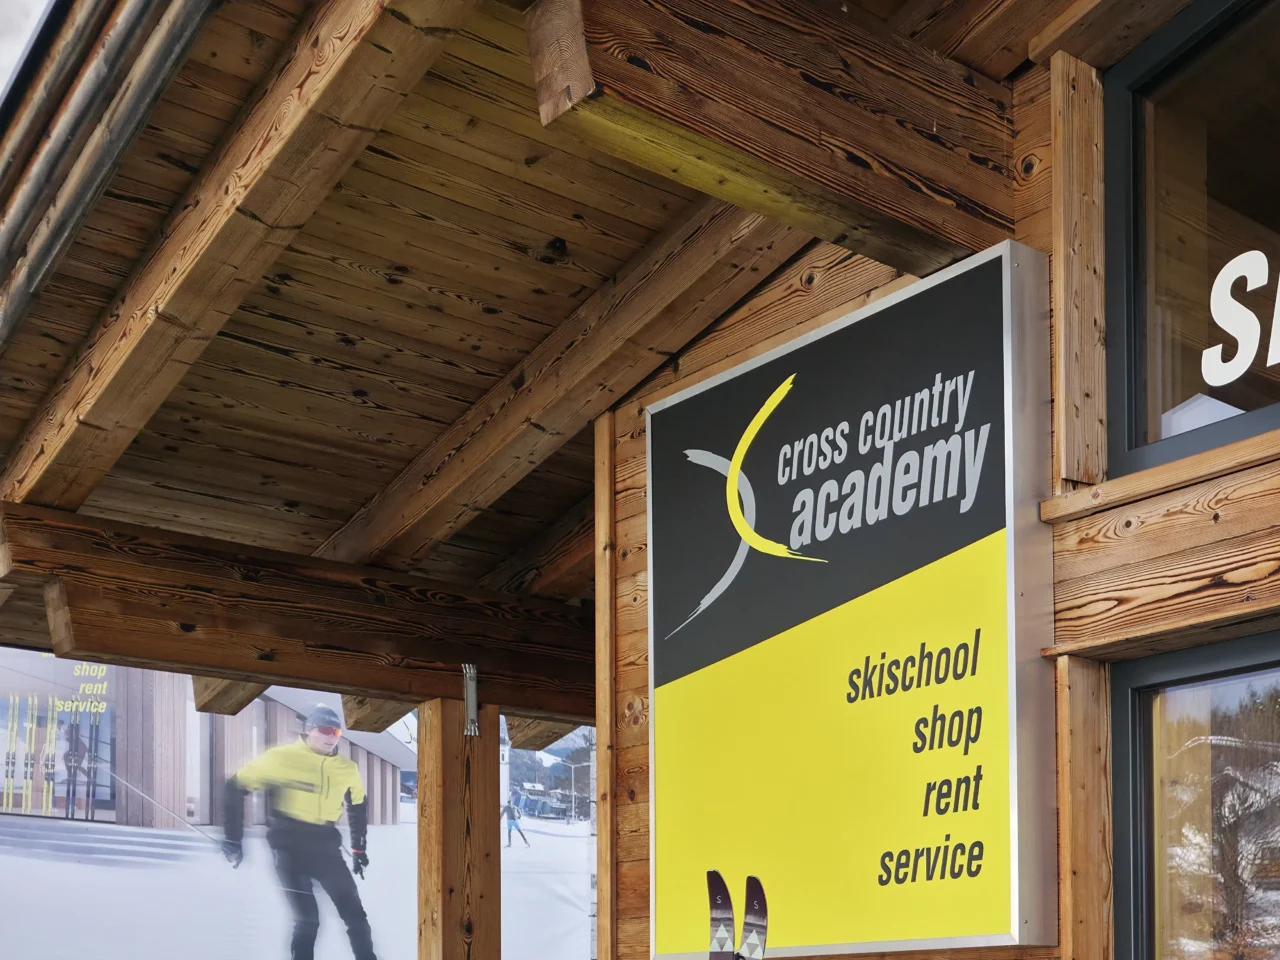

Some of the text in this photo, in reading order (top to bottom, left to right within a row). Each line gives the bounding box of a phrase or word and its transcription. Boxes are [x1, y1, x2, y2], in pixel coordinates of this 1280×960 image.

[777, 370, 975, 486] cross country
[789, 423, 991, 551] academy
[73, 661, 107, 679] shop
[79, 681, 107, 695] rent
[846, 629, 982, 703] skischool
[56, 697, 107, 713] service
[912, 704, 983, 757] shop
[922, 765, 983, 817] rent
[877, 832, 984, 887] service
